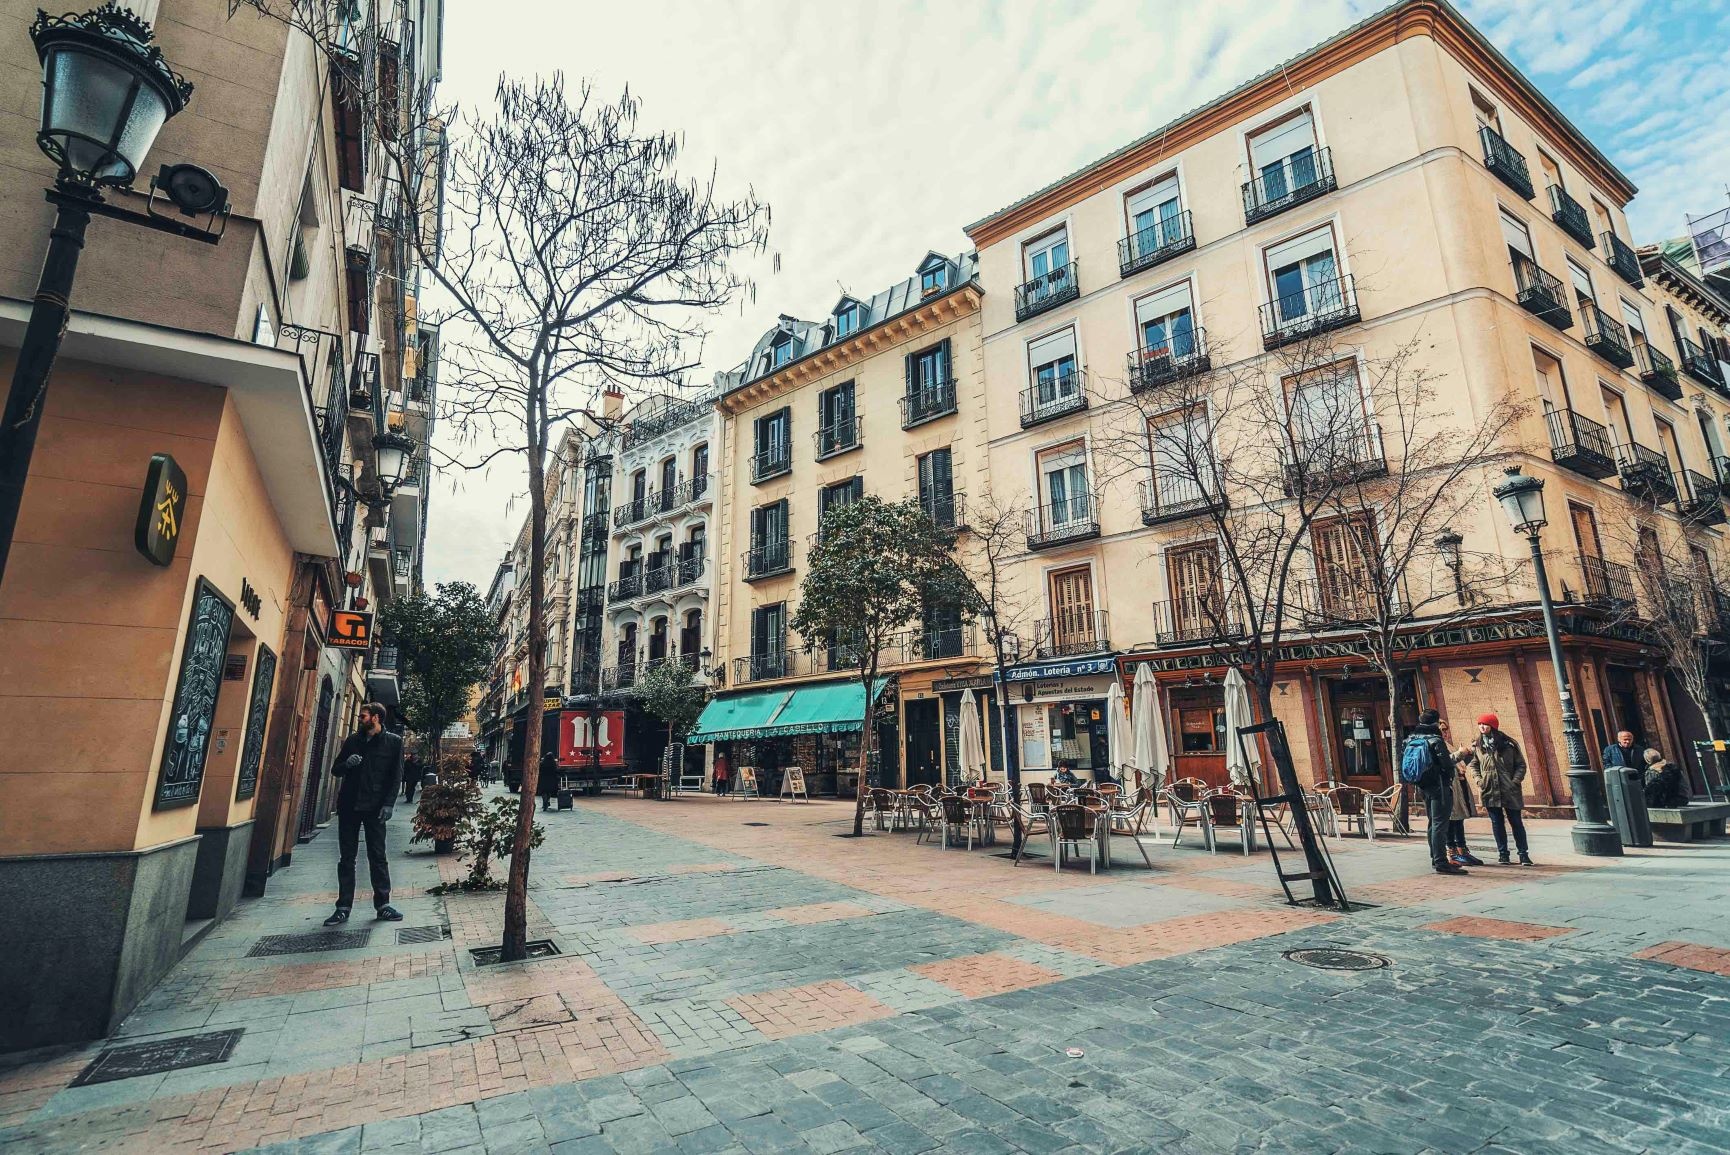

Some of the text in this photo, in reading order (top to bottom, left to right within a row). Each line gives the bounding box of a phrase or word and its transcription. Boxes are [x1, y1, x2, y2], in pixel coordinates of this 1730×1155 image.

[329, 637, 369, 646] TABACOS
[1087, 664, 1093, 672] 3
[1150, 657, 1188, 671] AFE
